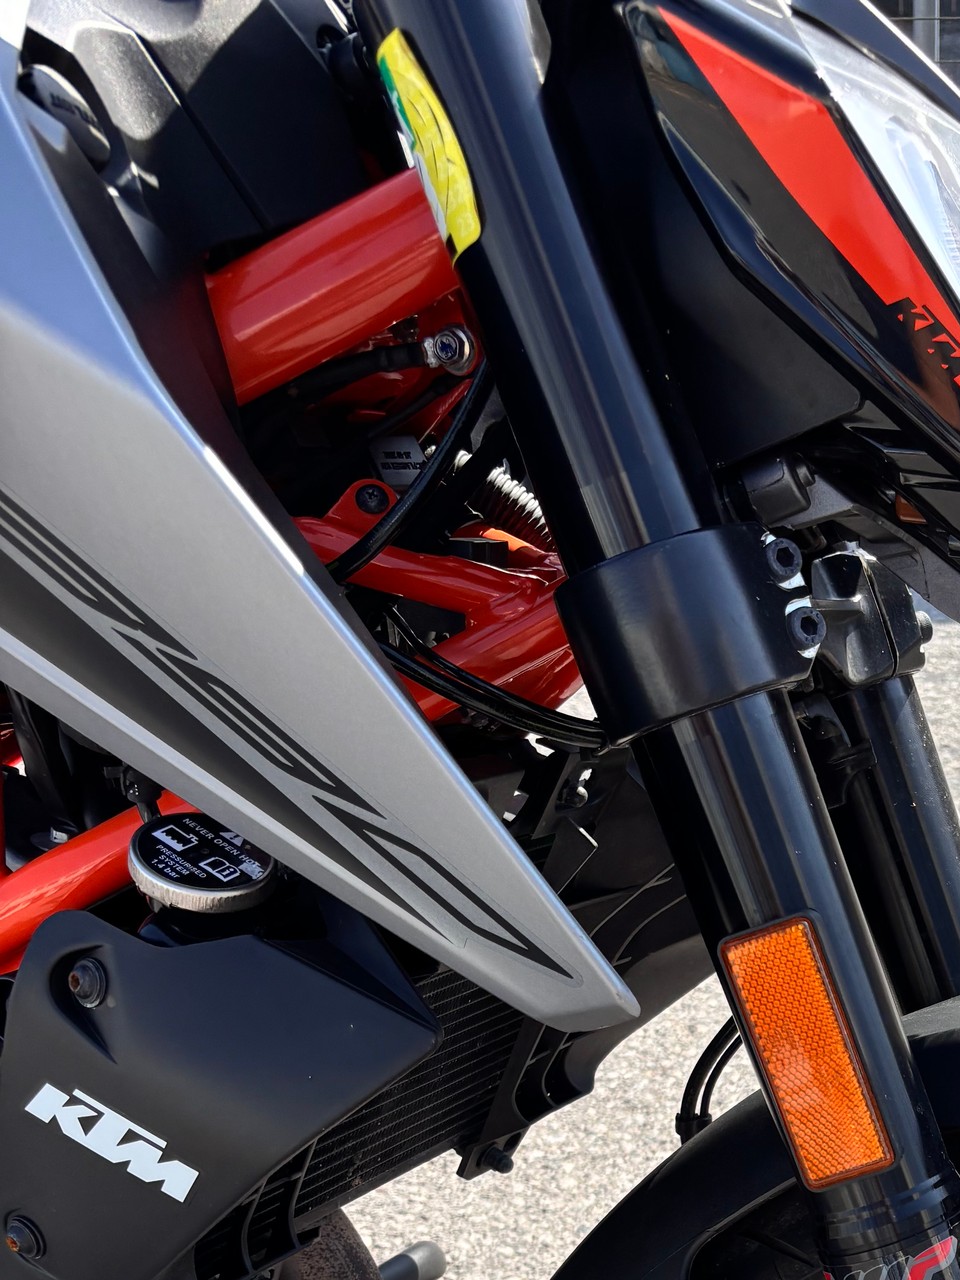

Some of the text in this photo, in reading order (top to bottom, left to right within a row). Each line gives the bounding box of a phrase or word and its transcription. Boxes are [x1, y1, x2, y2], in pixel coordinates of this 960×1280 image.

[182, 817, 215, 840] NEVER
[213, 838, 240, 856] OPEN
[151, 857, 181, 879] 1.4 bar
[155, 843, 207, 879] PRESSURISED
[158, 854, 190, 876] SYSTEM
[23, 1082, 200, 1203] KTM
